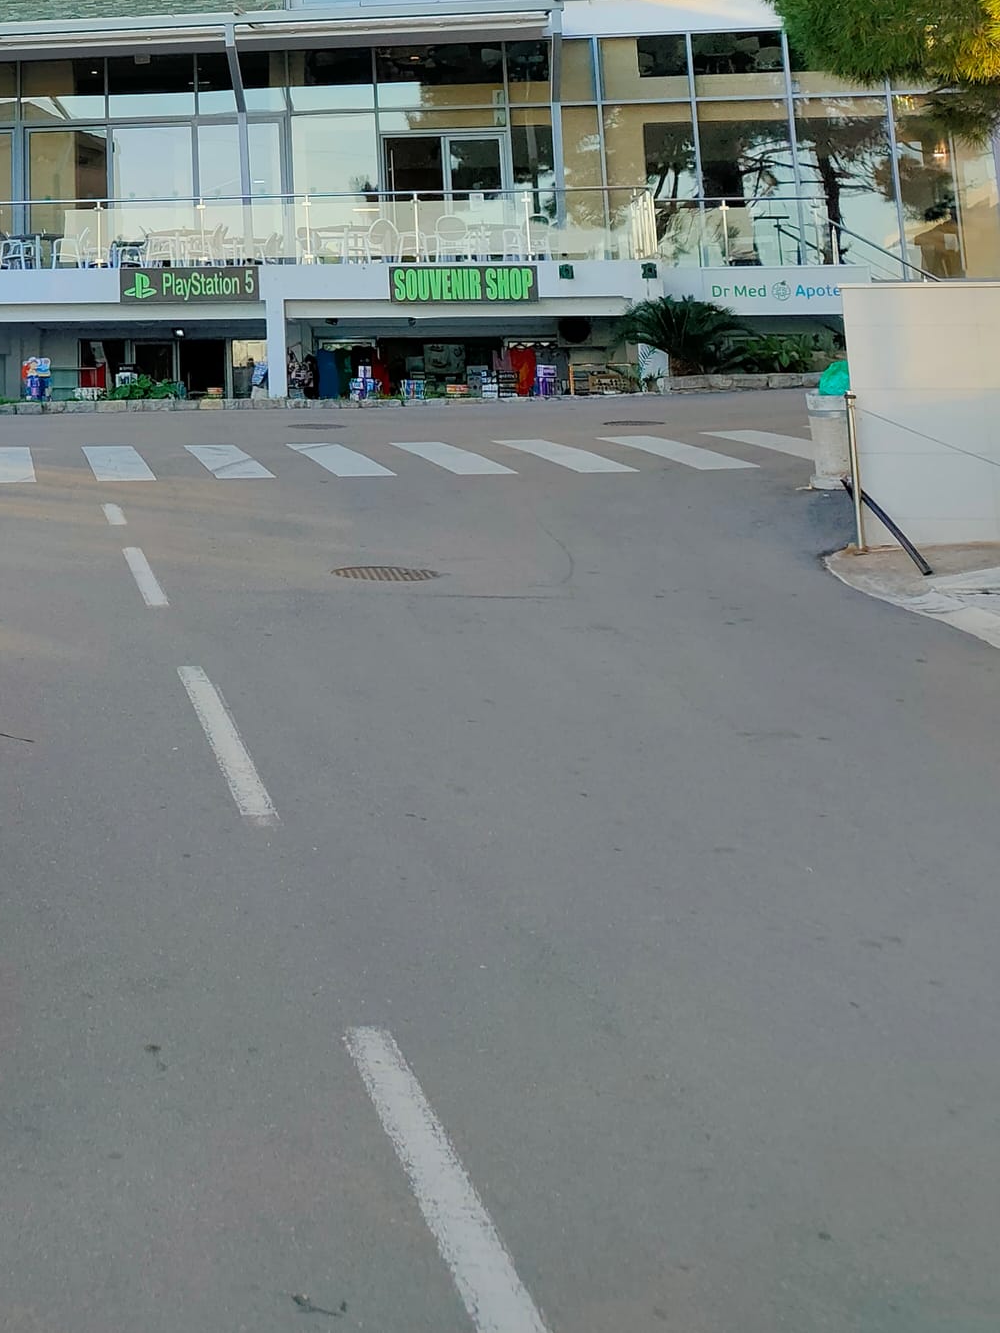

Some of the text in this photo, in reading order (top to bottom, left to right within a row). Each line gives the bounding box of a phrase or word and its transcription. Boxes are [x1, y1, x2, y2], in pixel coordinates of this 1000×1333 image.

[162, 269, 255, 301] PlayStation 5
[393, 267, 533, 301] SOUVENIR SHOP
[712, 285, 730, 298] Dr
[734, 284, 767, 298] Med
